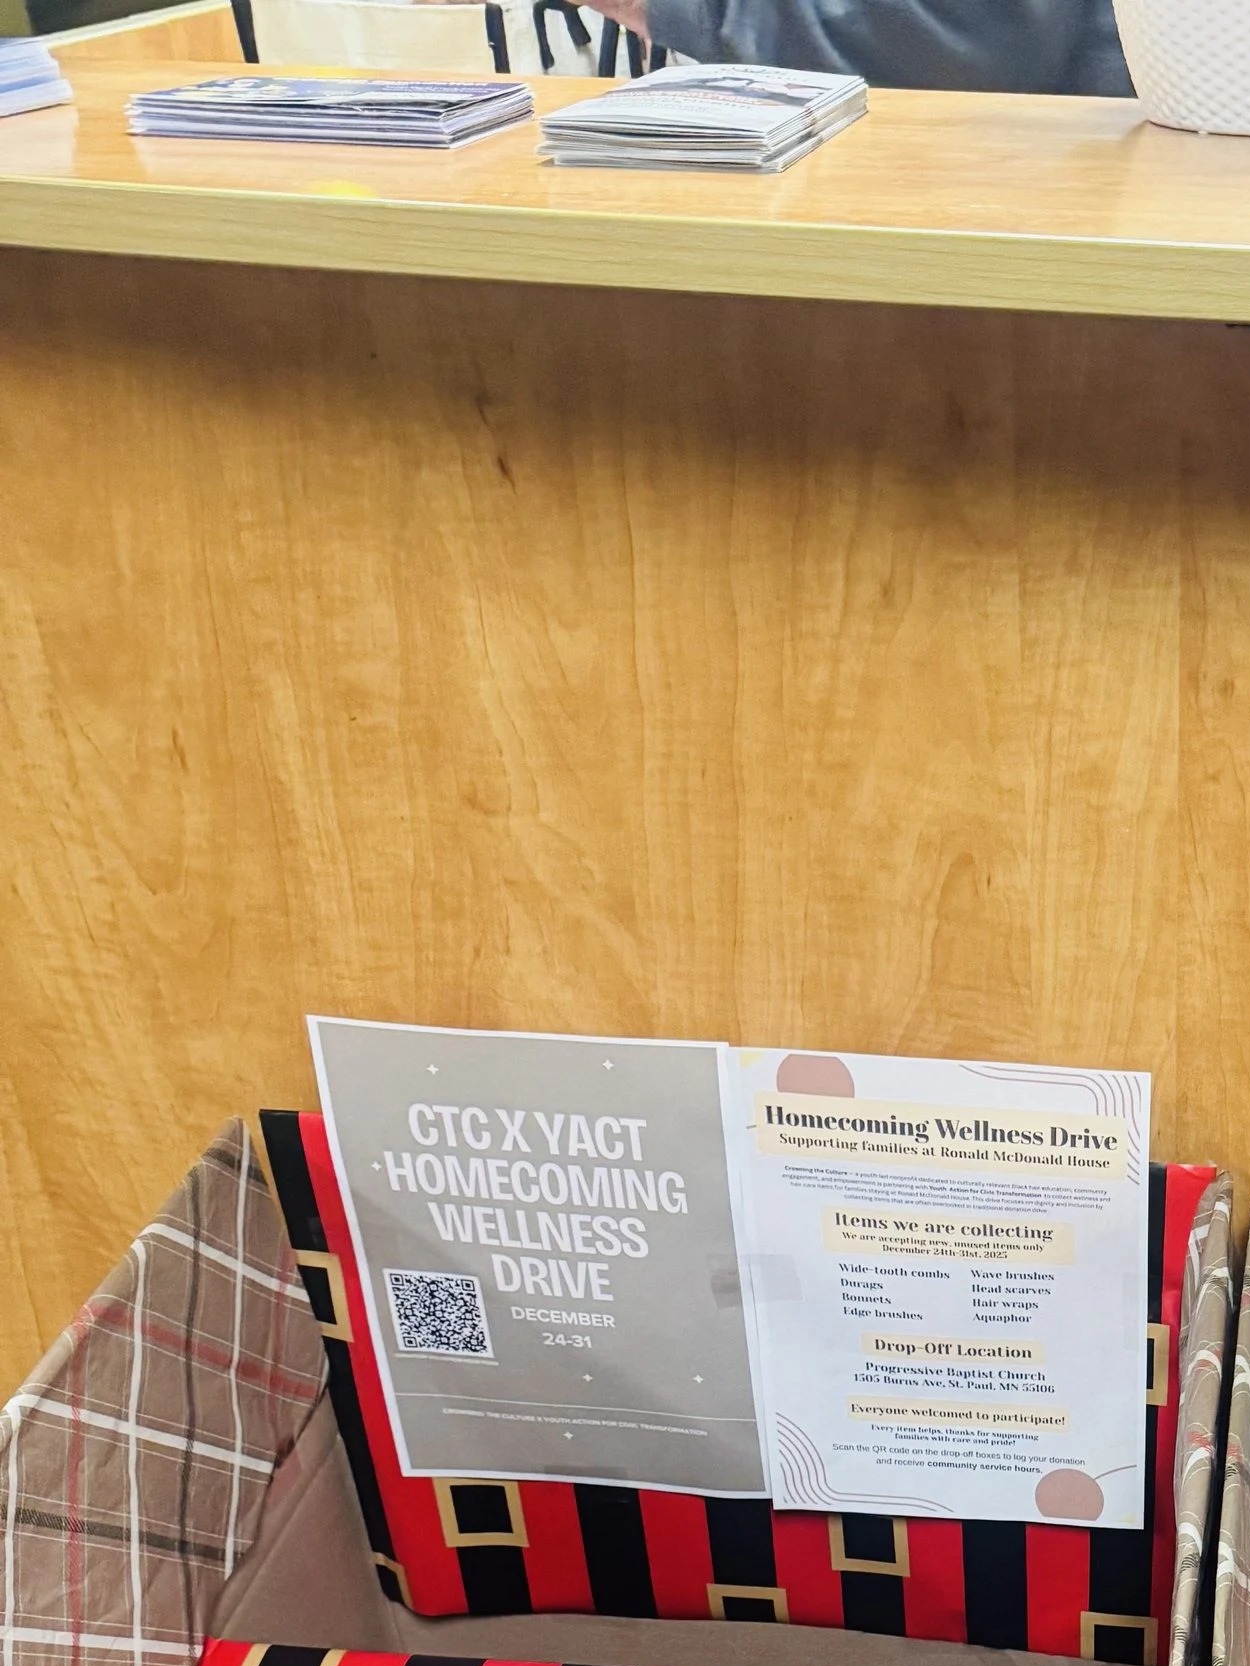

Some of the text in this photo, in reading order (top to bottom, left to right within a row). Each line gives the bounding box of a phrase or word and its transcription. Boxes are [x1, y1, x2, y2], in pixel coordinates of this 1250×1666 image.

[408, 1103, 647, 1161] CTC X YACT
[765, 1105, 1118, 1150] Homecoming Wellness Drive
[779, 1133, 1110, 1168] Supporting families at Ronald McDonald House
[383, 1151, 688, 1214] HOMECOMING
[427, 1202, 649, 1258] WELLNESS
[836, 1212, 1054, 1242] Items we are collecting
[842, 1231, 857, 1239] We
[878, 1236, 926, 1246] accepting
[1023, 1244, 1043, 1252] only
[882, 1244, 931, 1255] December
[983, 1251, 1008, 1259] 2025
[491, 1253, 614, 1301] DRIVE
[839, 1263, 950, 1279] Wide-tooth combs
[971, 1269, 1054, 1280] Wave brushes
[841, 1278, 883, 1290] Durags
[972, 1284, 1051, 1295] Head scarves
[842, 1292, 891, 1304] Bonnets
[973, 1298, 1039, 1310] Hair wraps
[511, 1306, 616, 1328] DECEMBER
[843, 1306, 923, 1320] Edge brushes
[973, 1313, 1032, 1324] Aquaphor
[542, 1332, 592, 1348] 24-31
[875, 1339, 1032, 1358] Drop-Off Location
[866, 1362, 1045, 1381] Progressive Baptist Church
[854, 1373, 880, 1383] 1505
[883, 1375, 919, 1386] Burns
[948, 1380, 964, 1388] St.
[999, 1382, 1018, 1391] MN
[1022, 1383, 1055, 1393] 55106
[851, 1403, 1065, 1426] Everyone welcomed to participate!
[832, 1443, 855, 1451] Scan
[856, 1444, 870, 1452] the
[872, 1445, 887, 1454] QR
[925, 1448, 939, 1456] the
[940, 1449, 974, 1458] drop-off
[975, 1451, 1001, 1460] boxes
[1013, 1453, 1027, 1462] log
[1049, 1456, 1086, 1465] donation
[927, 1461, 977, 1471] community
